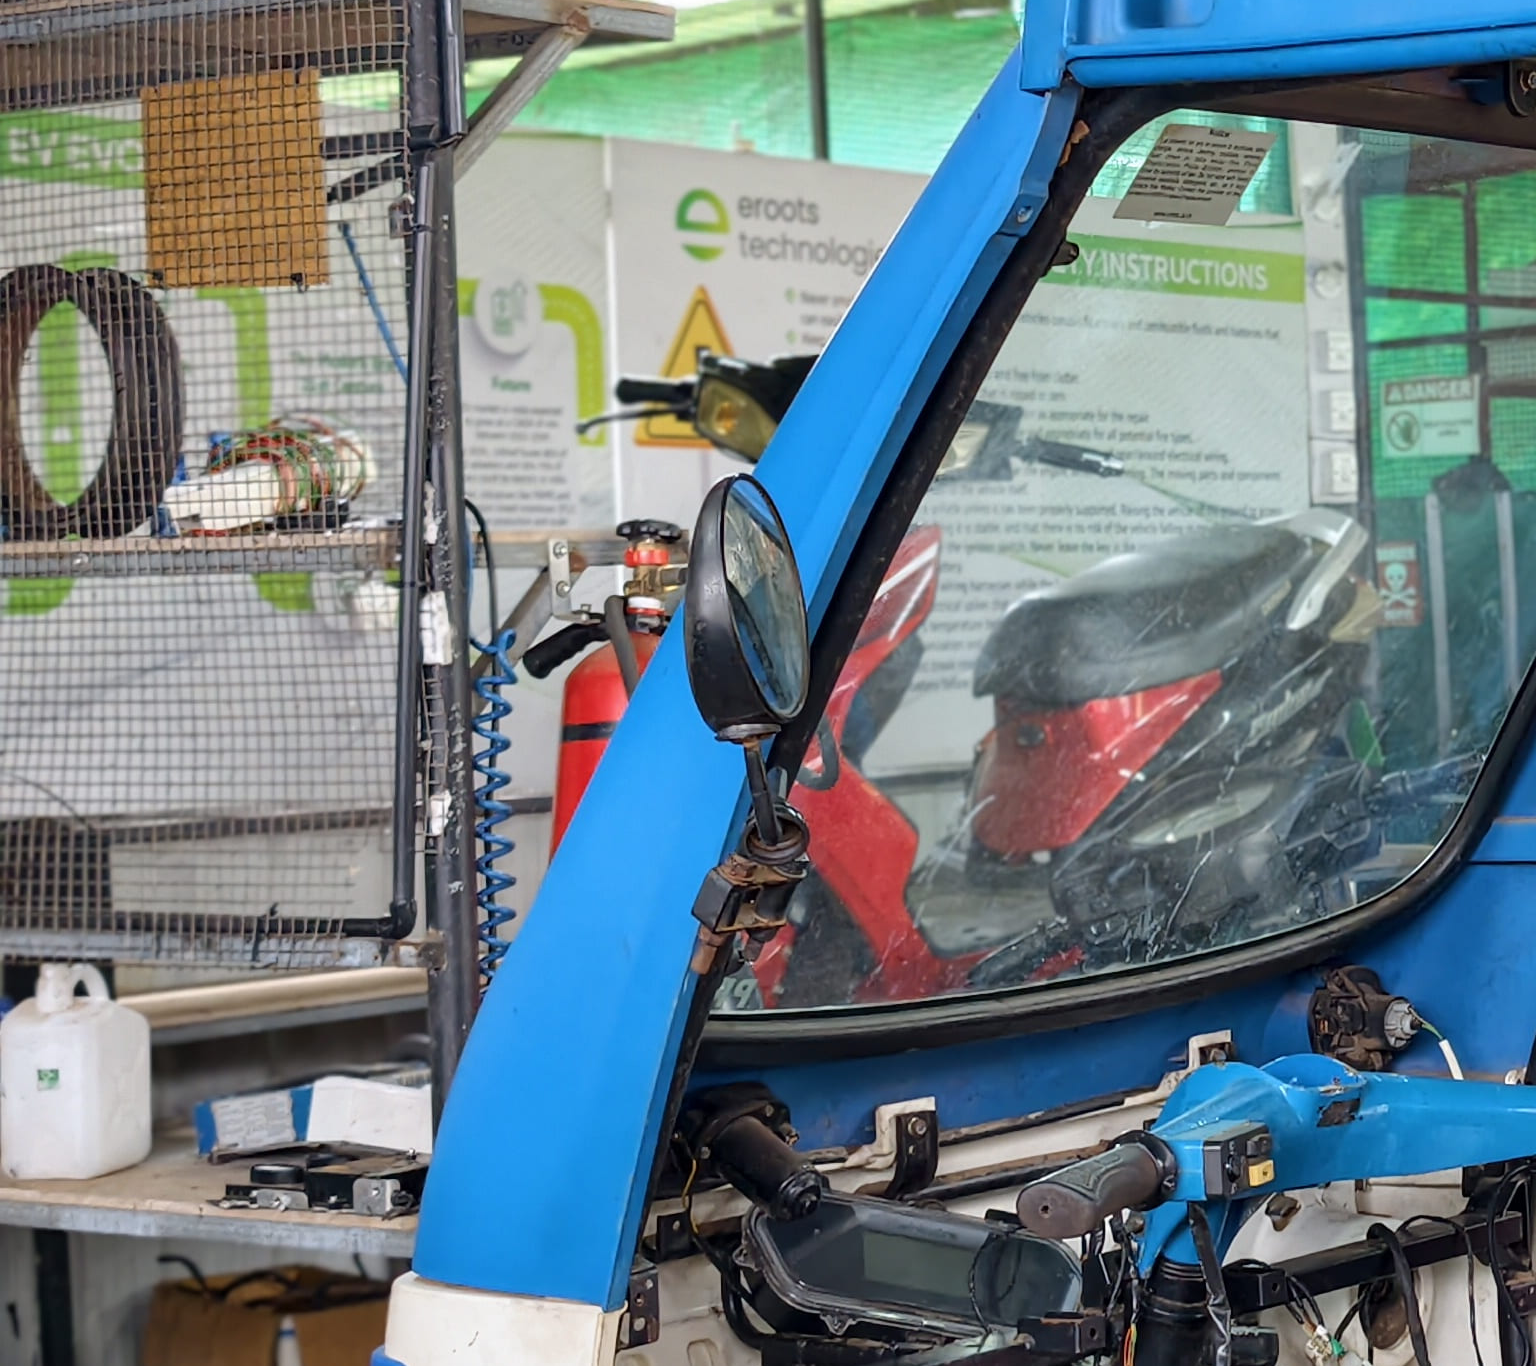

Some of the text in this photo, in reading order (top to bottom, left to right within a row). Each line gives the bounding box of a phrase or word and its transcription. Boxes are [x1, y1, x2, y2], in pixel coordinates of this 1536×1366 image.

[9, 127, 58, 166] EV
[737, 195, 820, 225] eroots
[1102, 252, 1269, 291] INSTRUCTIONS
